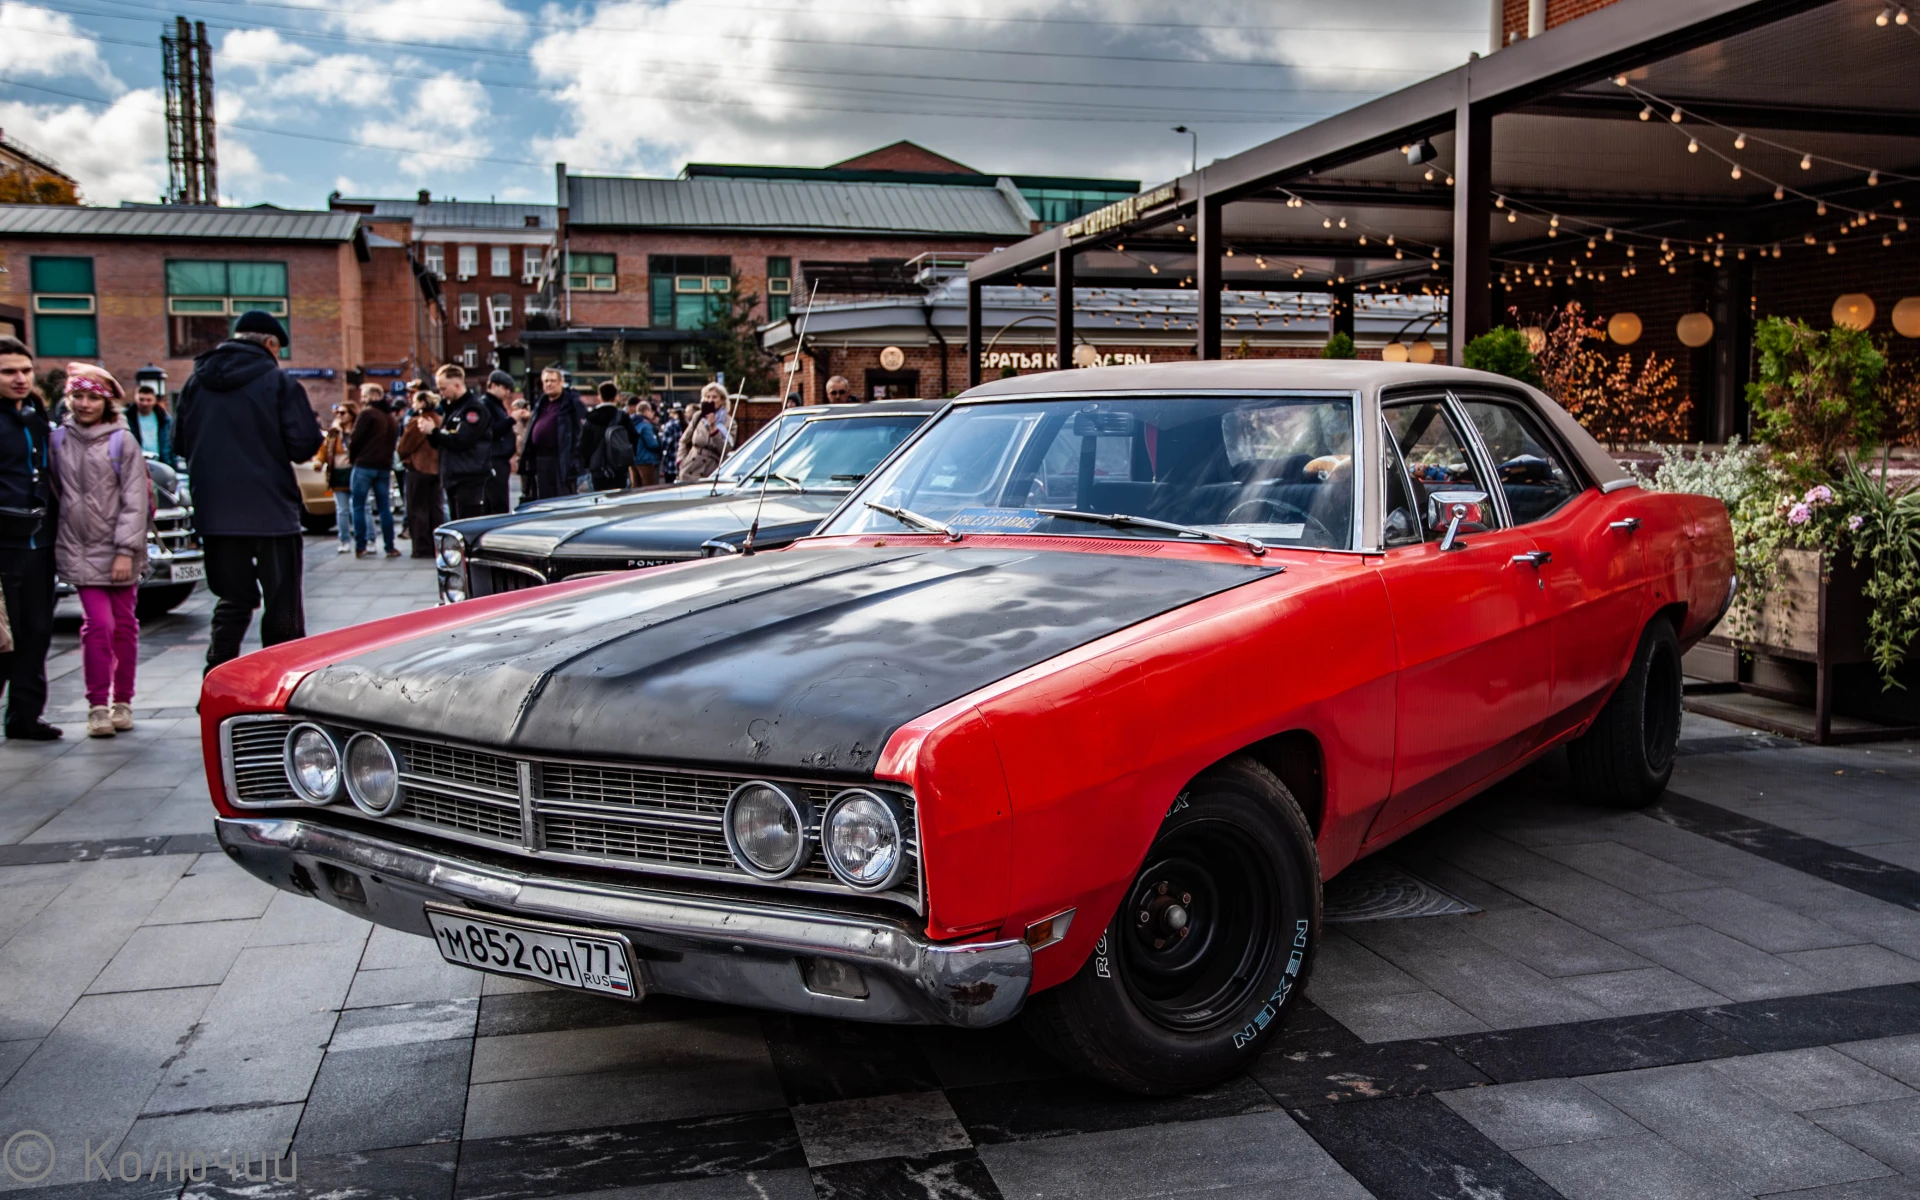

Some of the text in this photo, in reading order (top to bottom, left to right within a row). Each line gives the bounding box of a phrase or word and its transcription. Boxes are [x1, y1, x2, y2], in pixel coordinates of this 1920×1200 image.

[576, 942, 610, 975] 77
[584, 972, 610, 987] RUS
[1232, 919, 1309, 1049] NEXEN
